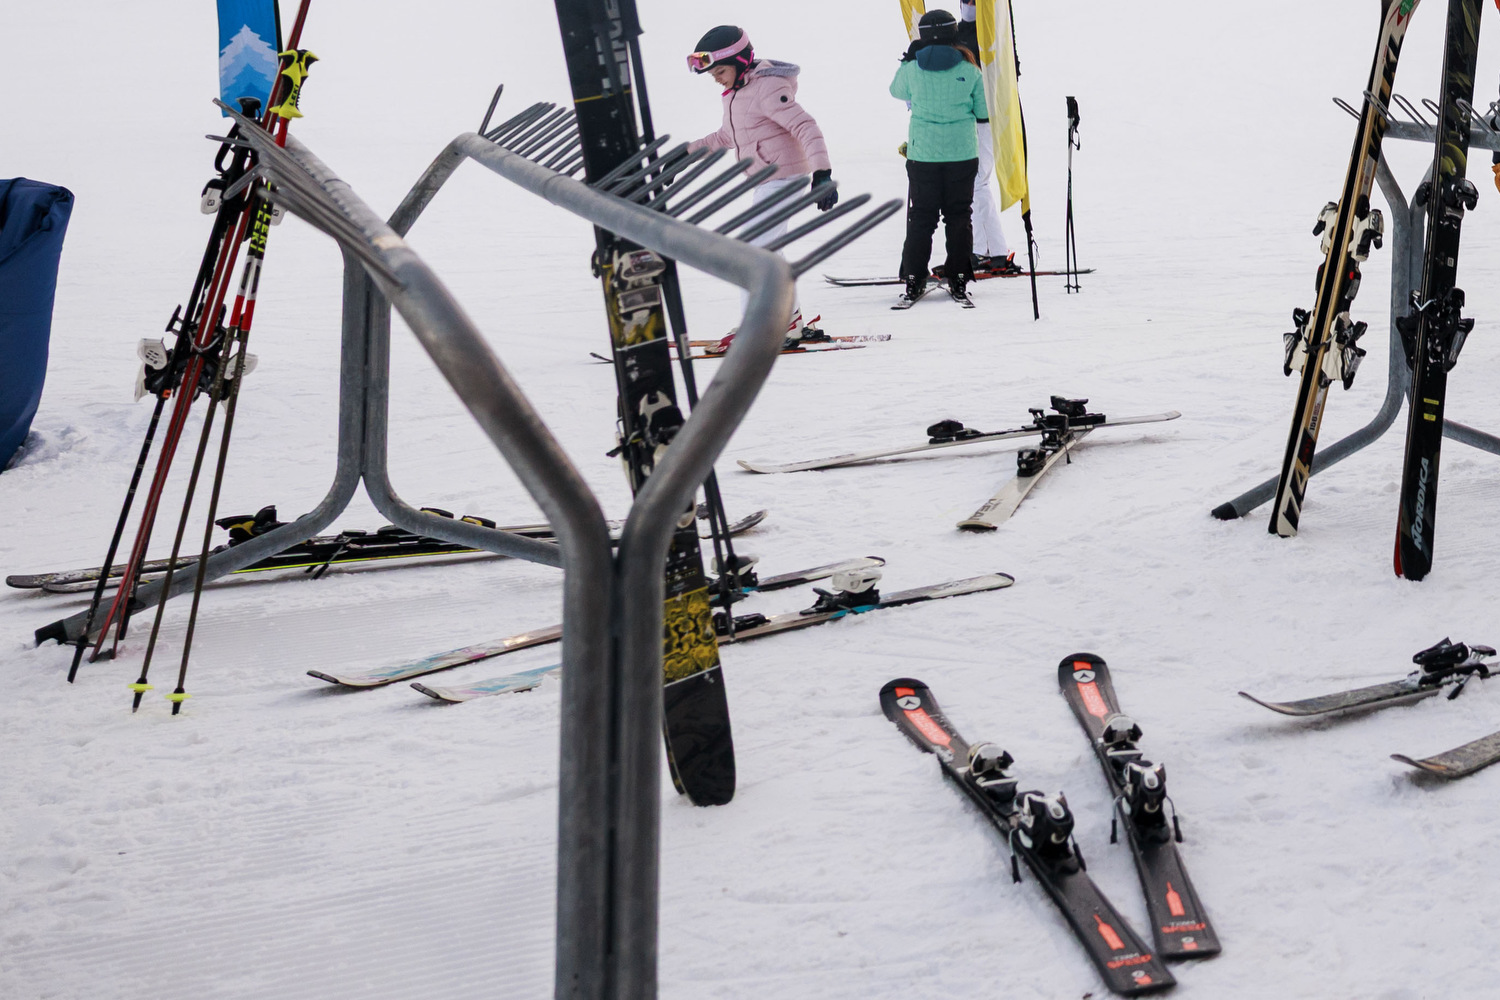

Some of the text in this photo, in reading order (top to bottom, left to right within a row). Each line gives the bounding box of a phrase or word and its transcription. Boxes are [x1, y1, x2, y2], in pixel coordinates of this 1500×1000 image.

[288, 84, 300, 107] LEKI
[250, 209, 263, 251] LEKI
[257, 212, 272, 254] LEKI
[1410, 456, 1430, 551] NORDICA
